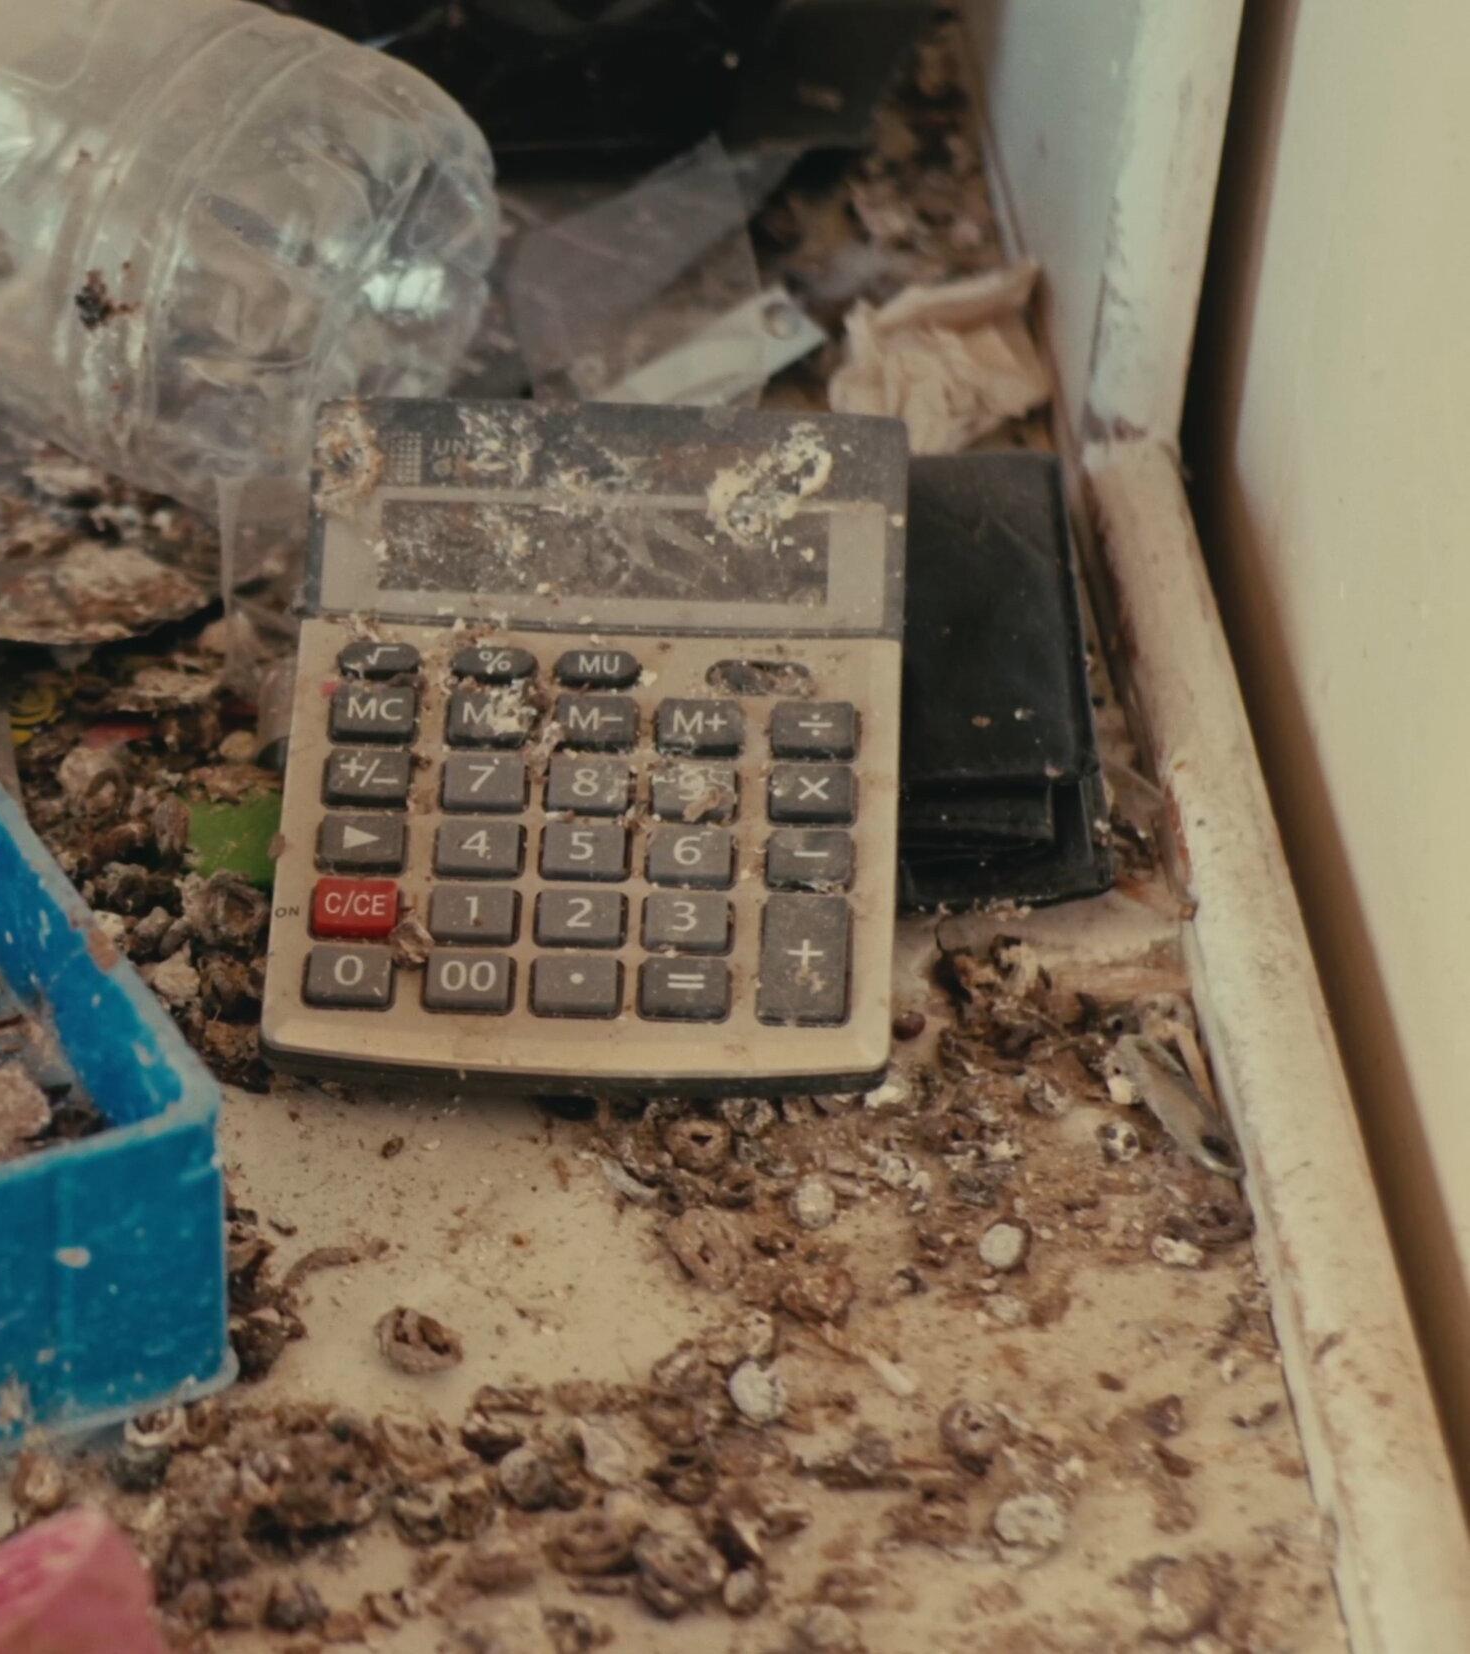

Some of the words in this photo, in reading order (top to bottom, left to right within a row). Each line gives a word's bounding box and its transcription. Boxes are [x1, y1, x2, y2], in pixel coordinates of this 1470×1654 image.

[579, 654, 621, 674] MU
[347, 697, 404, 721] MC
[672, 710, 728, 734] M+
[468, 764, 496, 793] 7
[571, 768, 600, 797] 8
[461, 829, 491, 858] 4
[569, 831, 595, 860] 5
[673, 836, 703, 865] 6
[274, 905, 301, 919] ON
[324, 890, 388, 917] C/CE
[465, 896, 480, 926] 1
[566, 898, 593, 928] 2
[671, 901, 698, 931] 3
[334, 954, 365, 987] 0
[440, 960, 497, 992] 00
